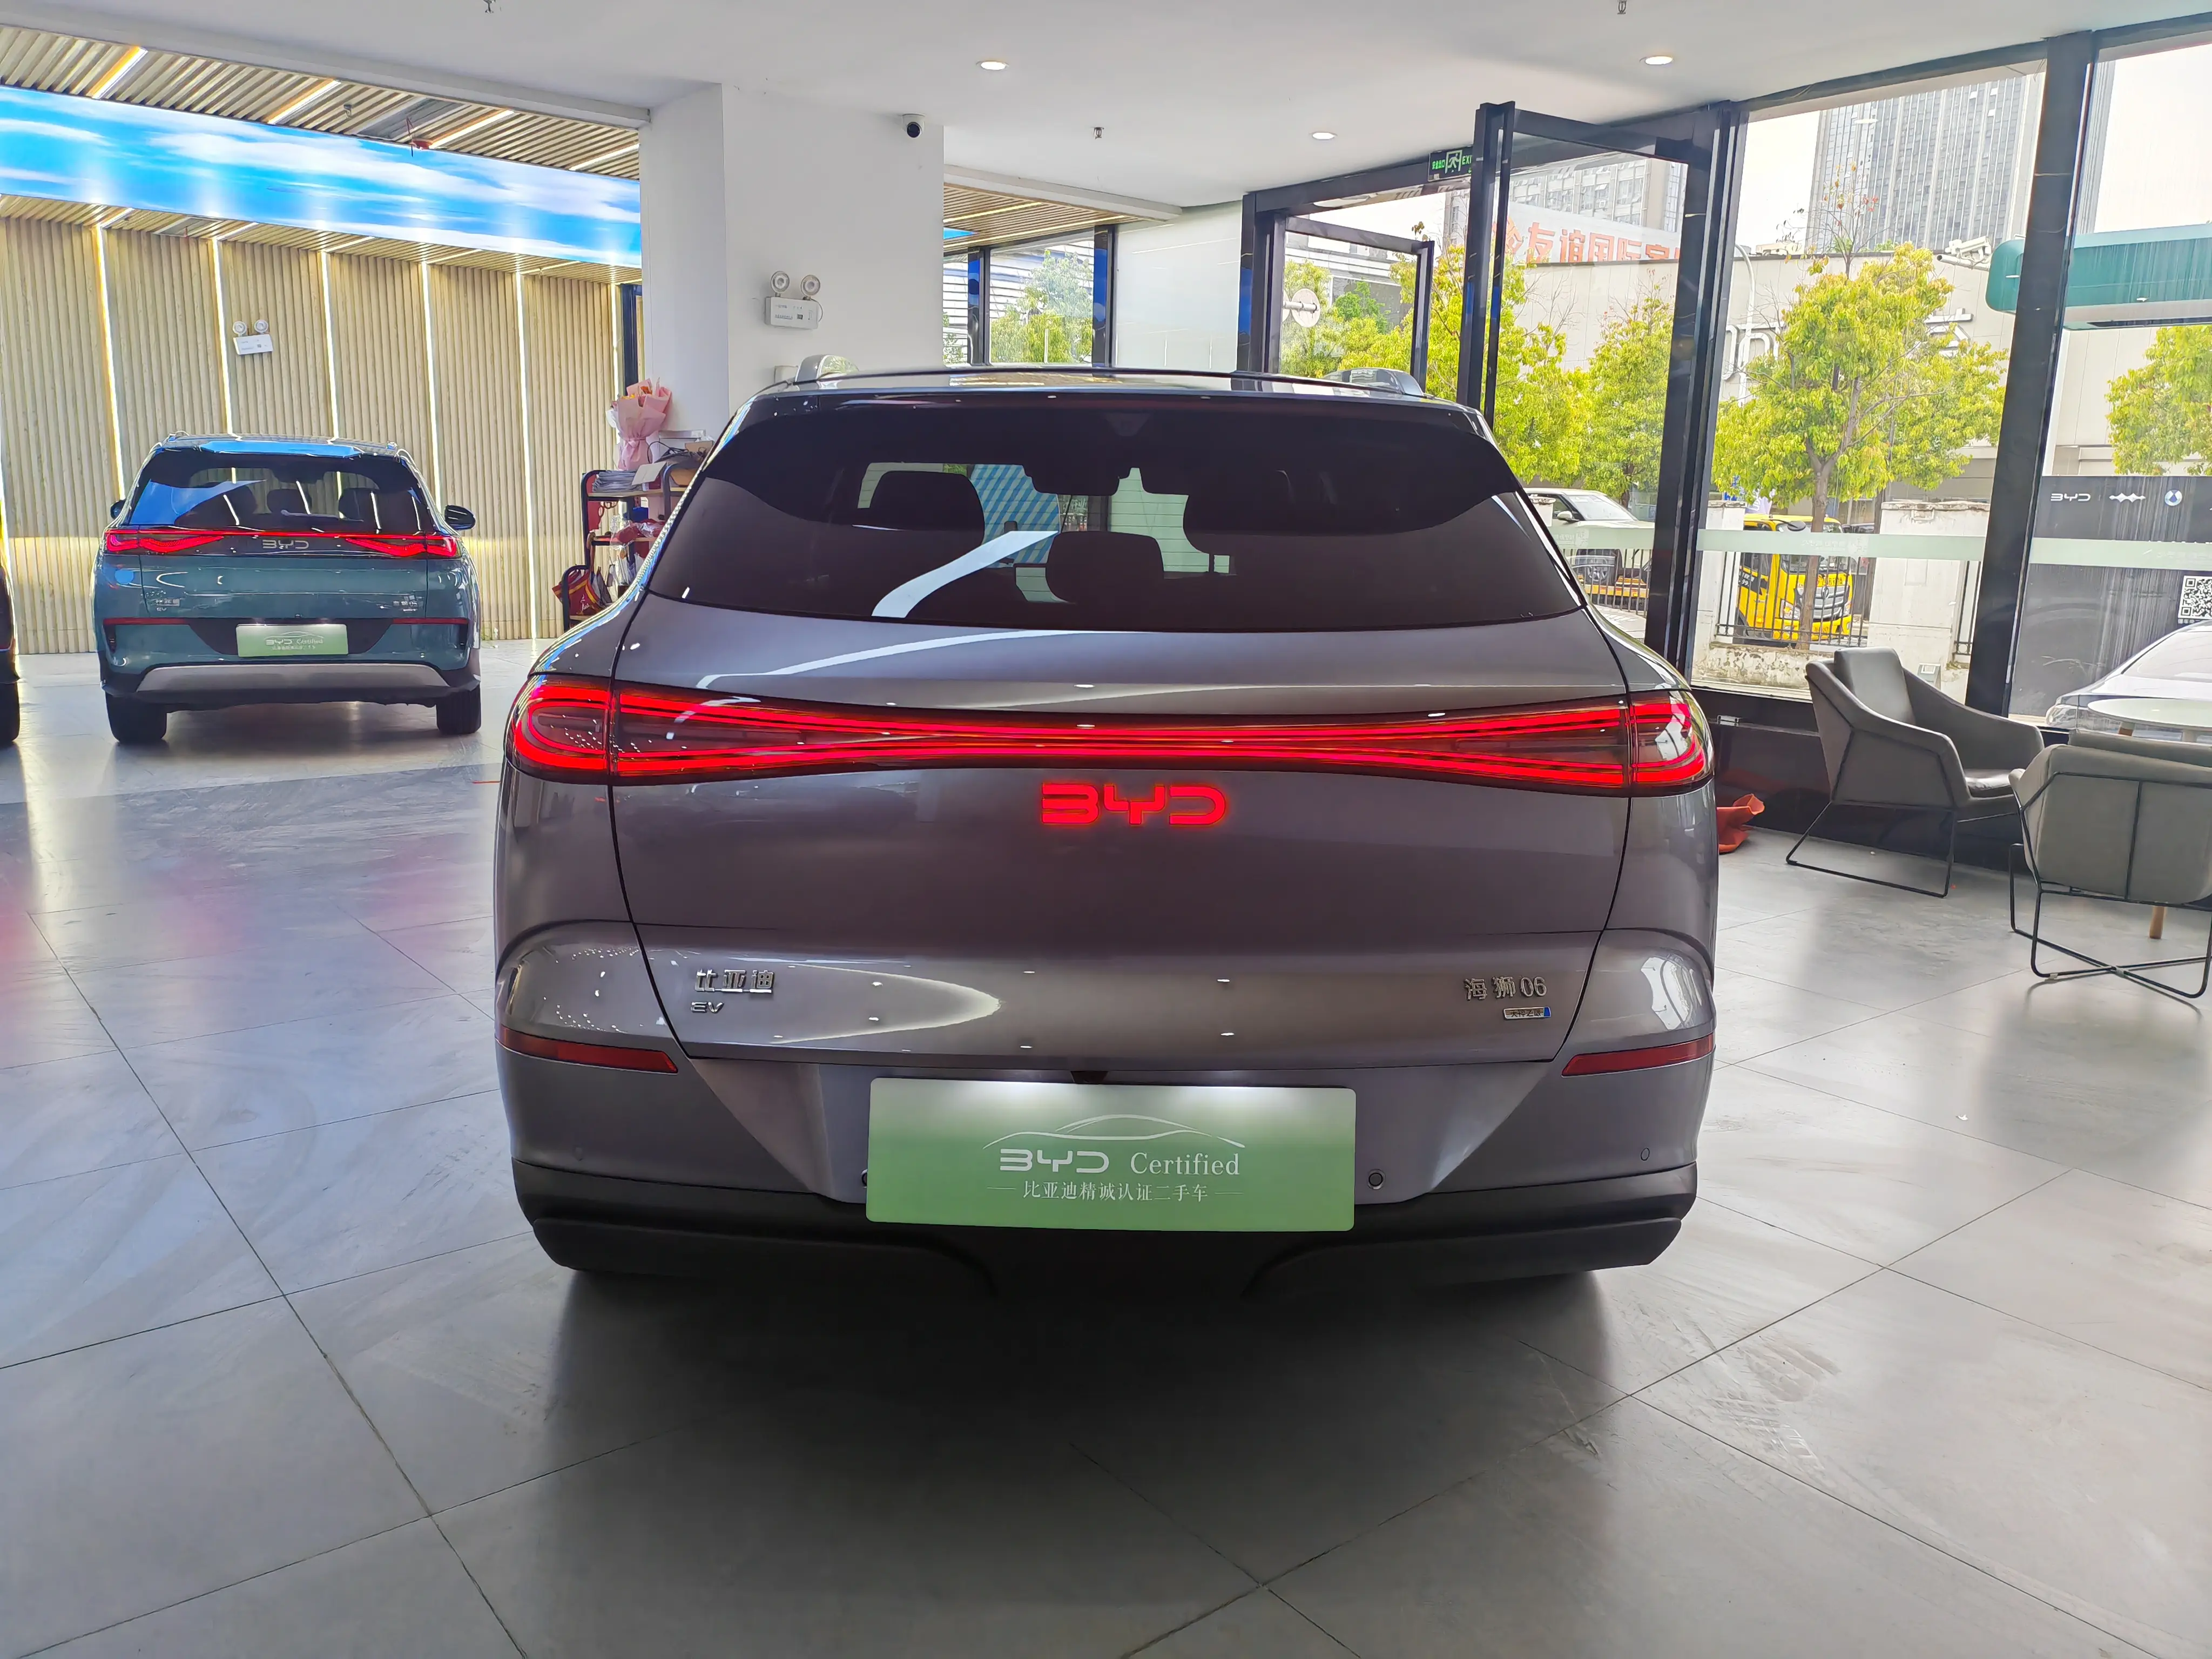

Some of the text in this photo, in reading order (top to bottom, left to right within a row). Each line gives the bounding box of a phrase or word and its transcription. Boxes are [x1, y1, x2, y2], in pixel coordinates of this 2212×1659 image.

[1462, 155, 1472, 165] EXI
[2050, 493, 2091, 502] BYD
[262, 539, 309, 549] BYD
[1041, 784, 1226, 824] BYD
[694, 969, 775, 993] 比亚迪
[690, 1001, 725, 1014] EV
[1000, 1149, 1240, 1175] BYD Certified
[1023, 1180, 1209, 1202] 比亚迪精诚认证二手车
